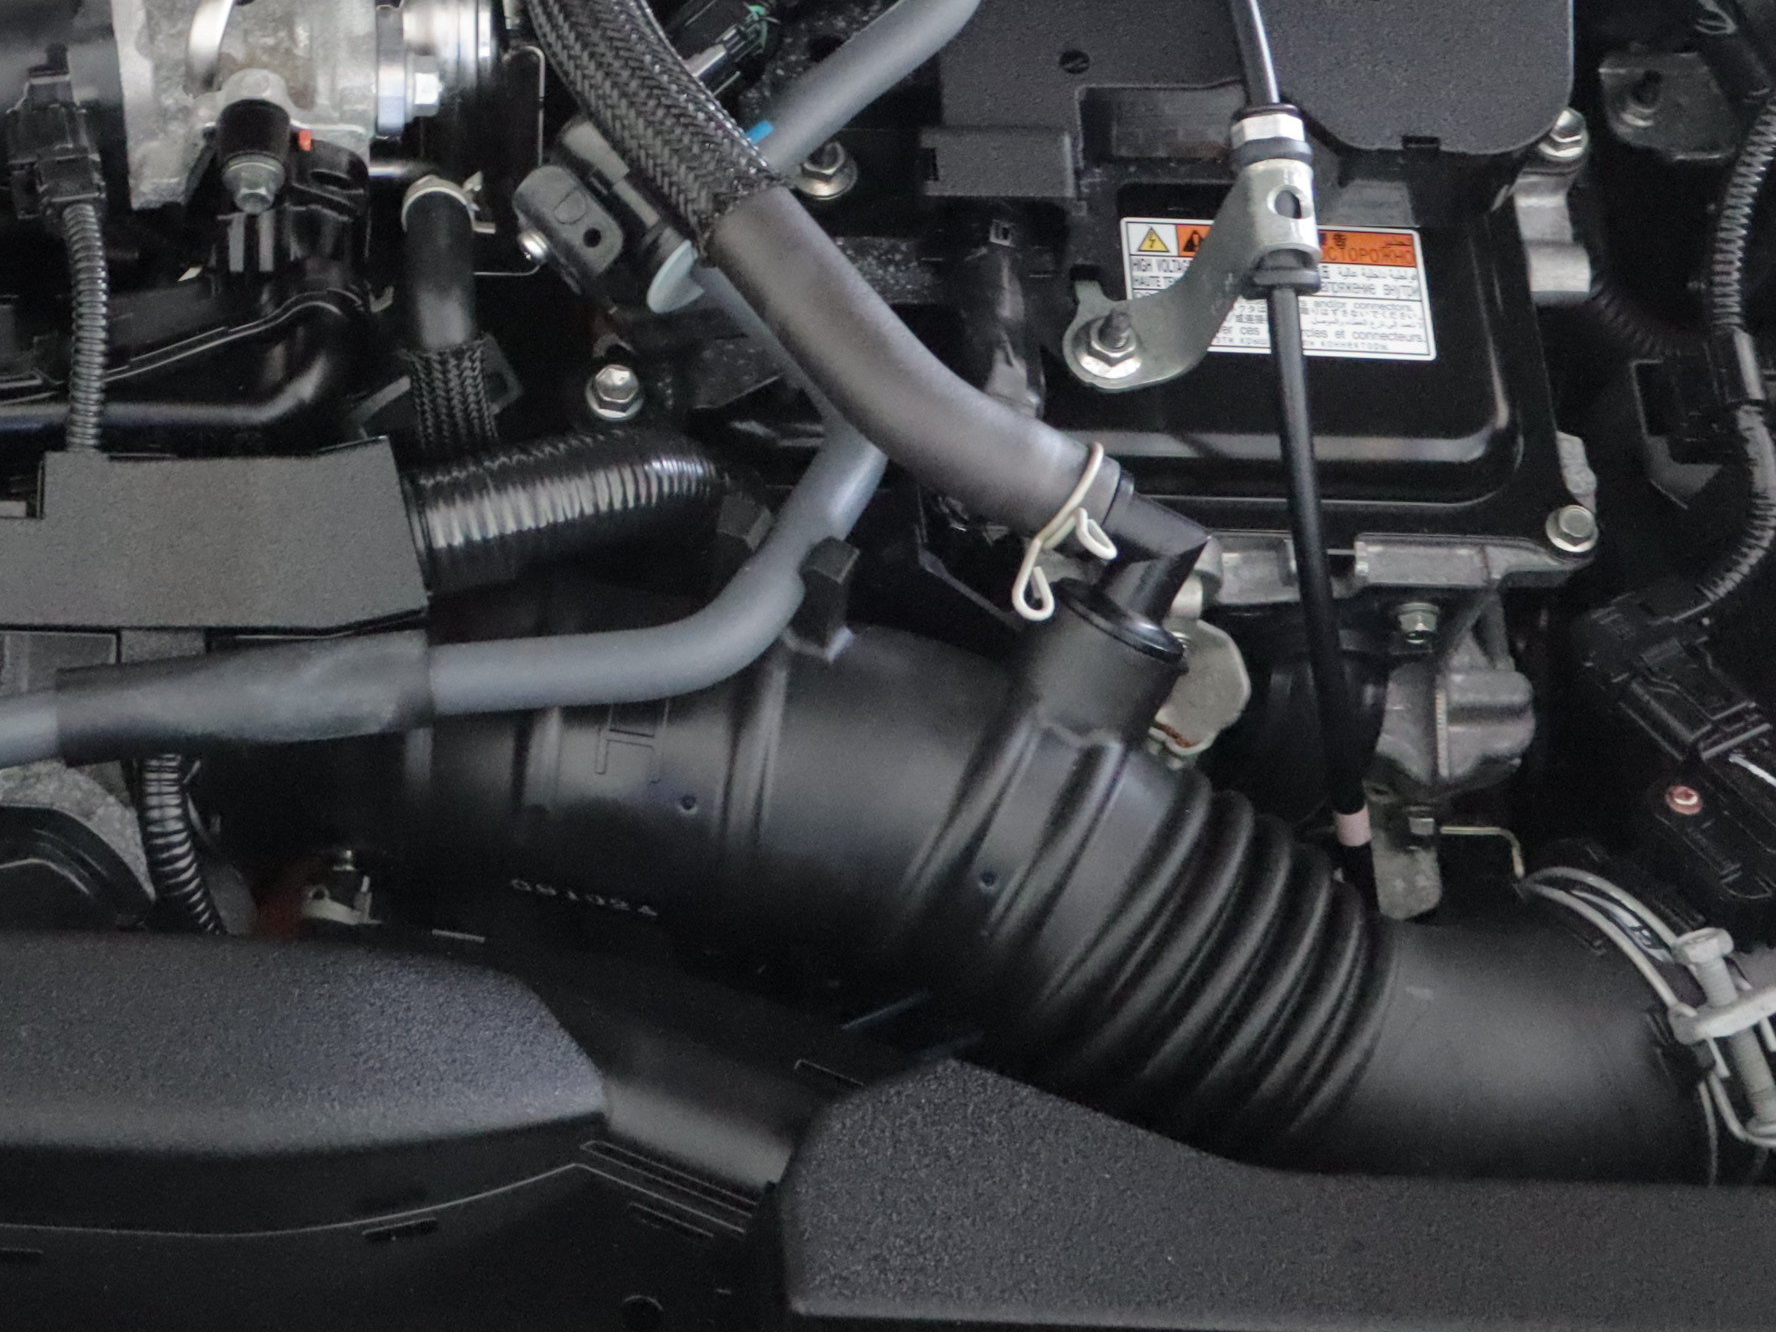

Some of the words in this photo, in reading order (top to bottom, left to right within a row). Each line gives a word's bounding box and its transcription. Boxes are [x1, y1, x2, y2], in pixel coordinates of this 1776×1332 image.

[1132, 257, 1152, 272] HIGH
[1156, 258, 1191, 273] VOLTAG
[1133, 274, 1160, 288] HAUTE
[1162, 275, 1177, 287] TE
